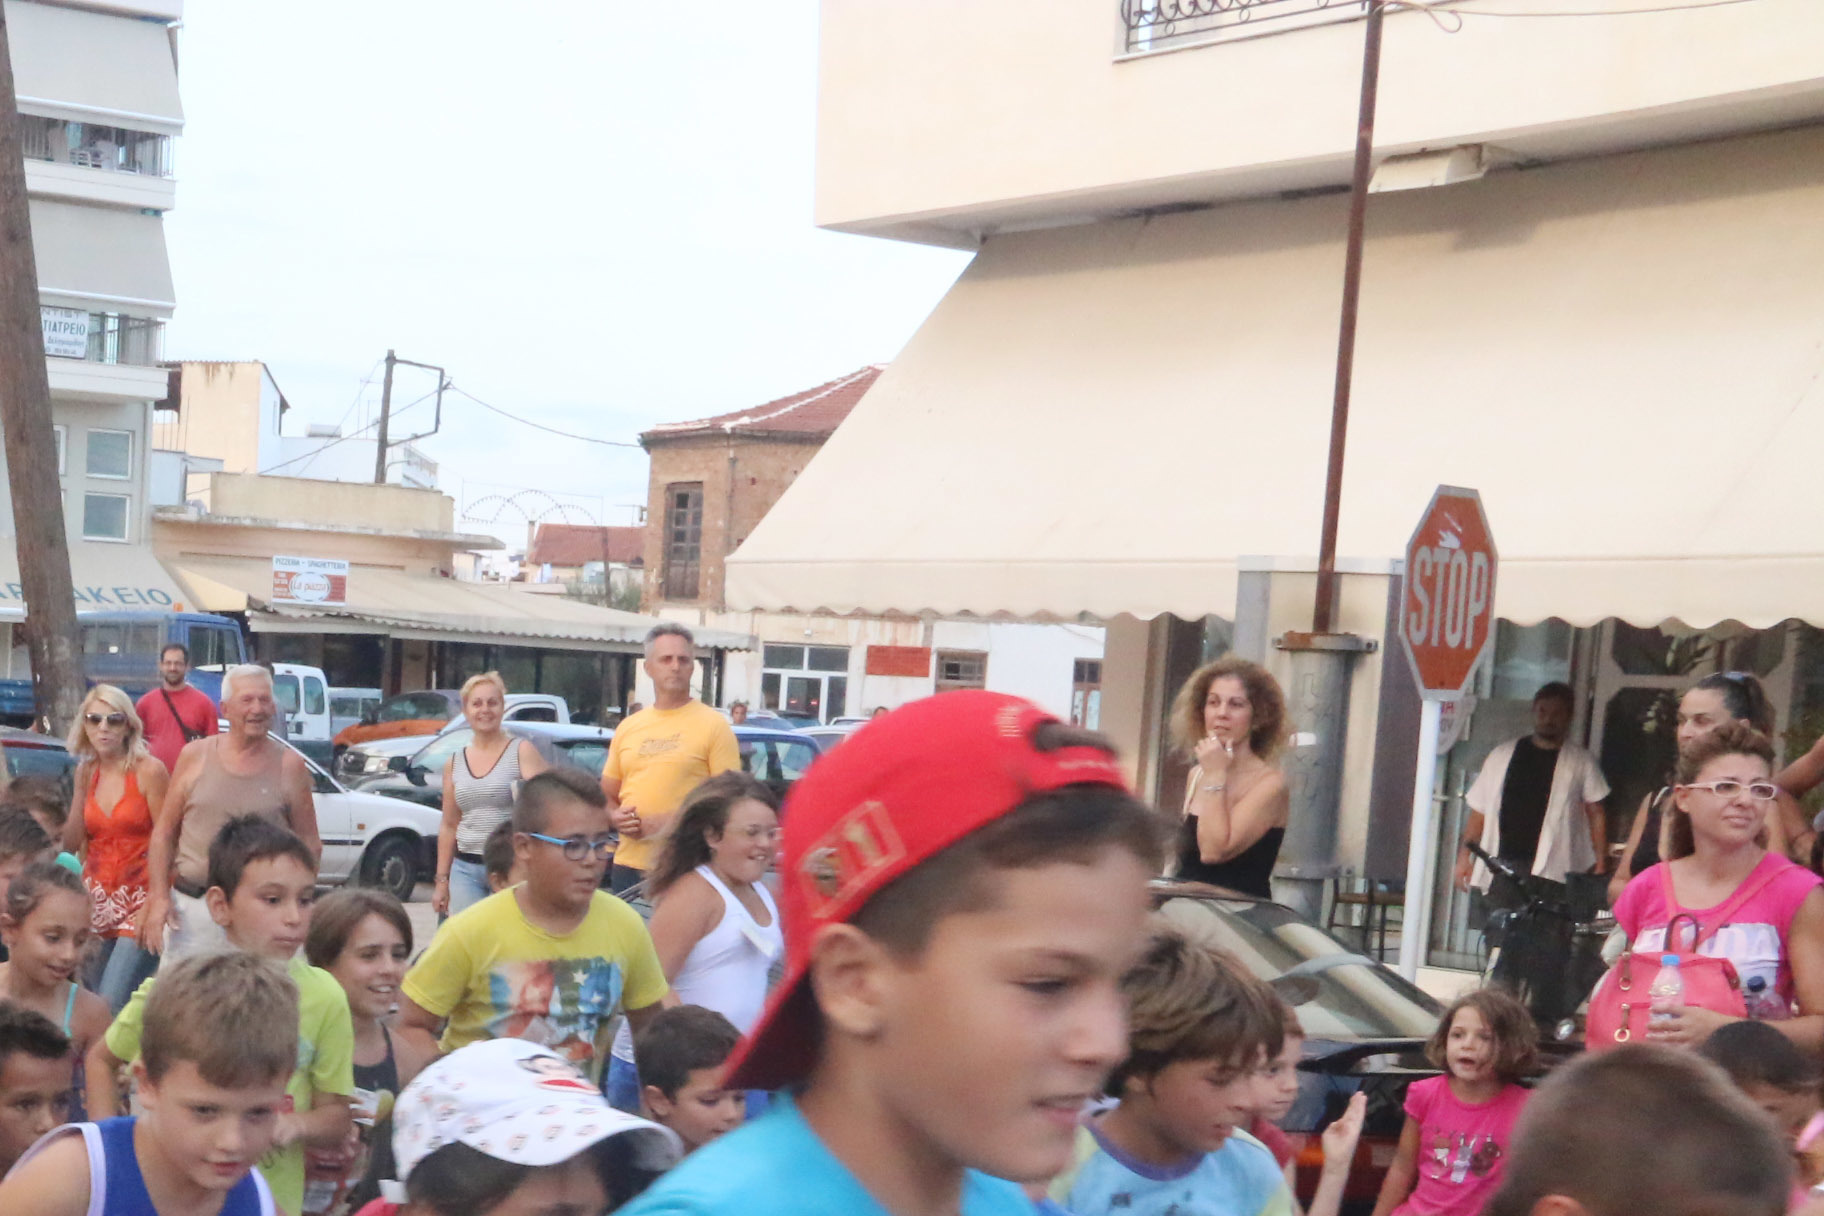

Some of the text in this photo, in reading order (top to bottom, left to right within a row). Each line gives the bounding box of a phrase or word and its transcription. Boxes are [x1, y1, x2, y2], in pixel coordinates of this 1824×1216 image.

[41, 307, 81, 319] NTIST
[43, 319, 87, 336] ΤΙΑΤΡΕΙΟ
[275, 557, 300, 567] PIZZERIA
[1409, 545, 1489, 650] STOP
